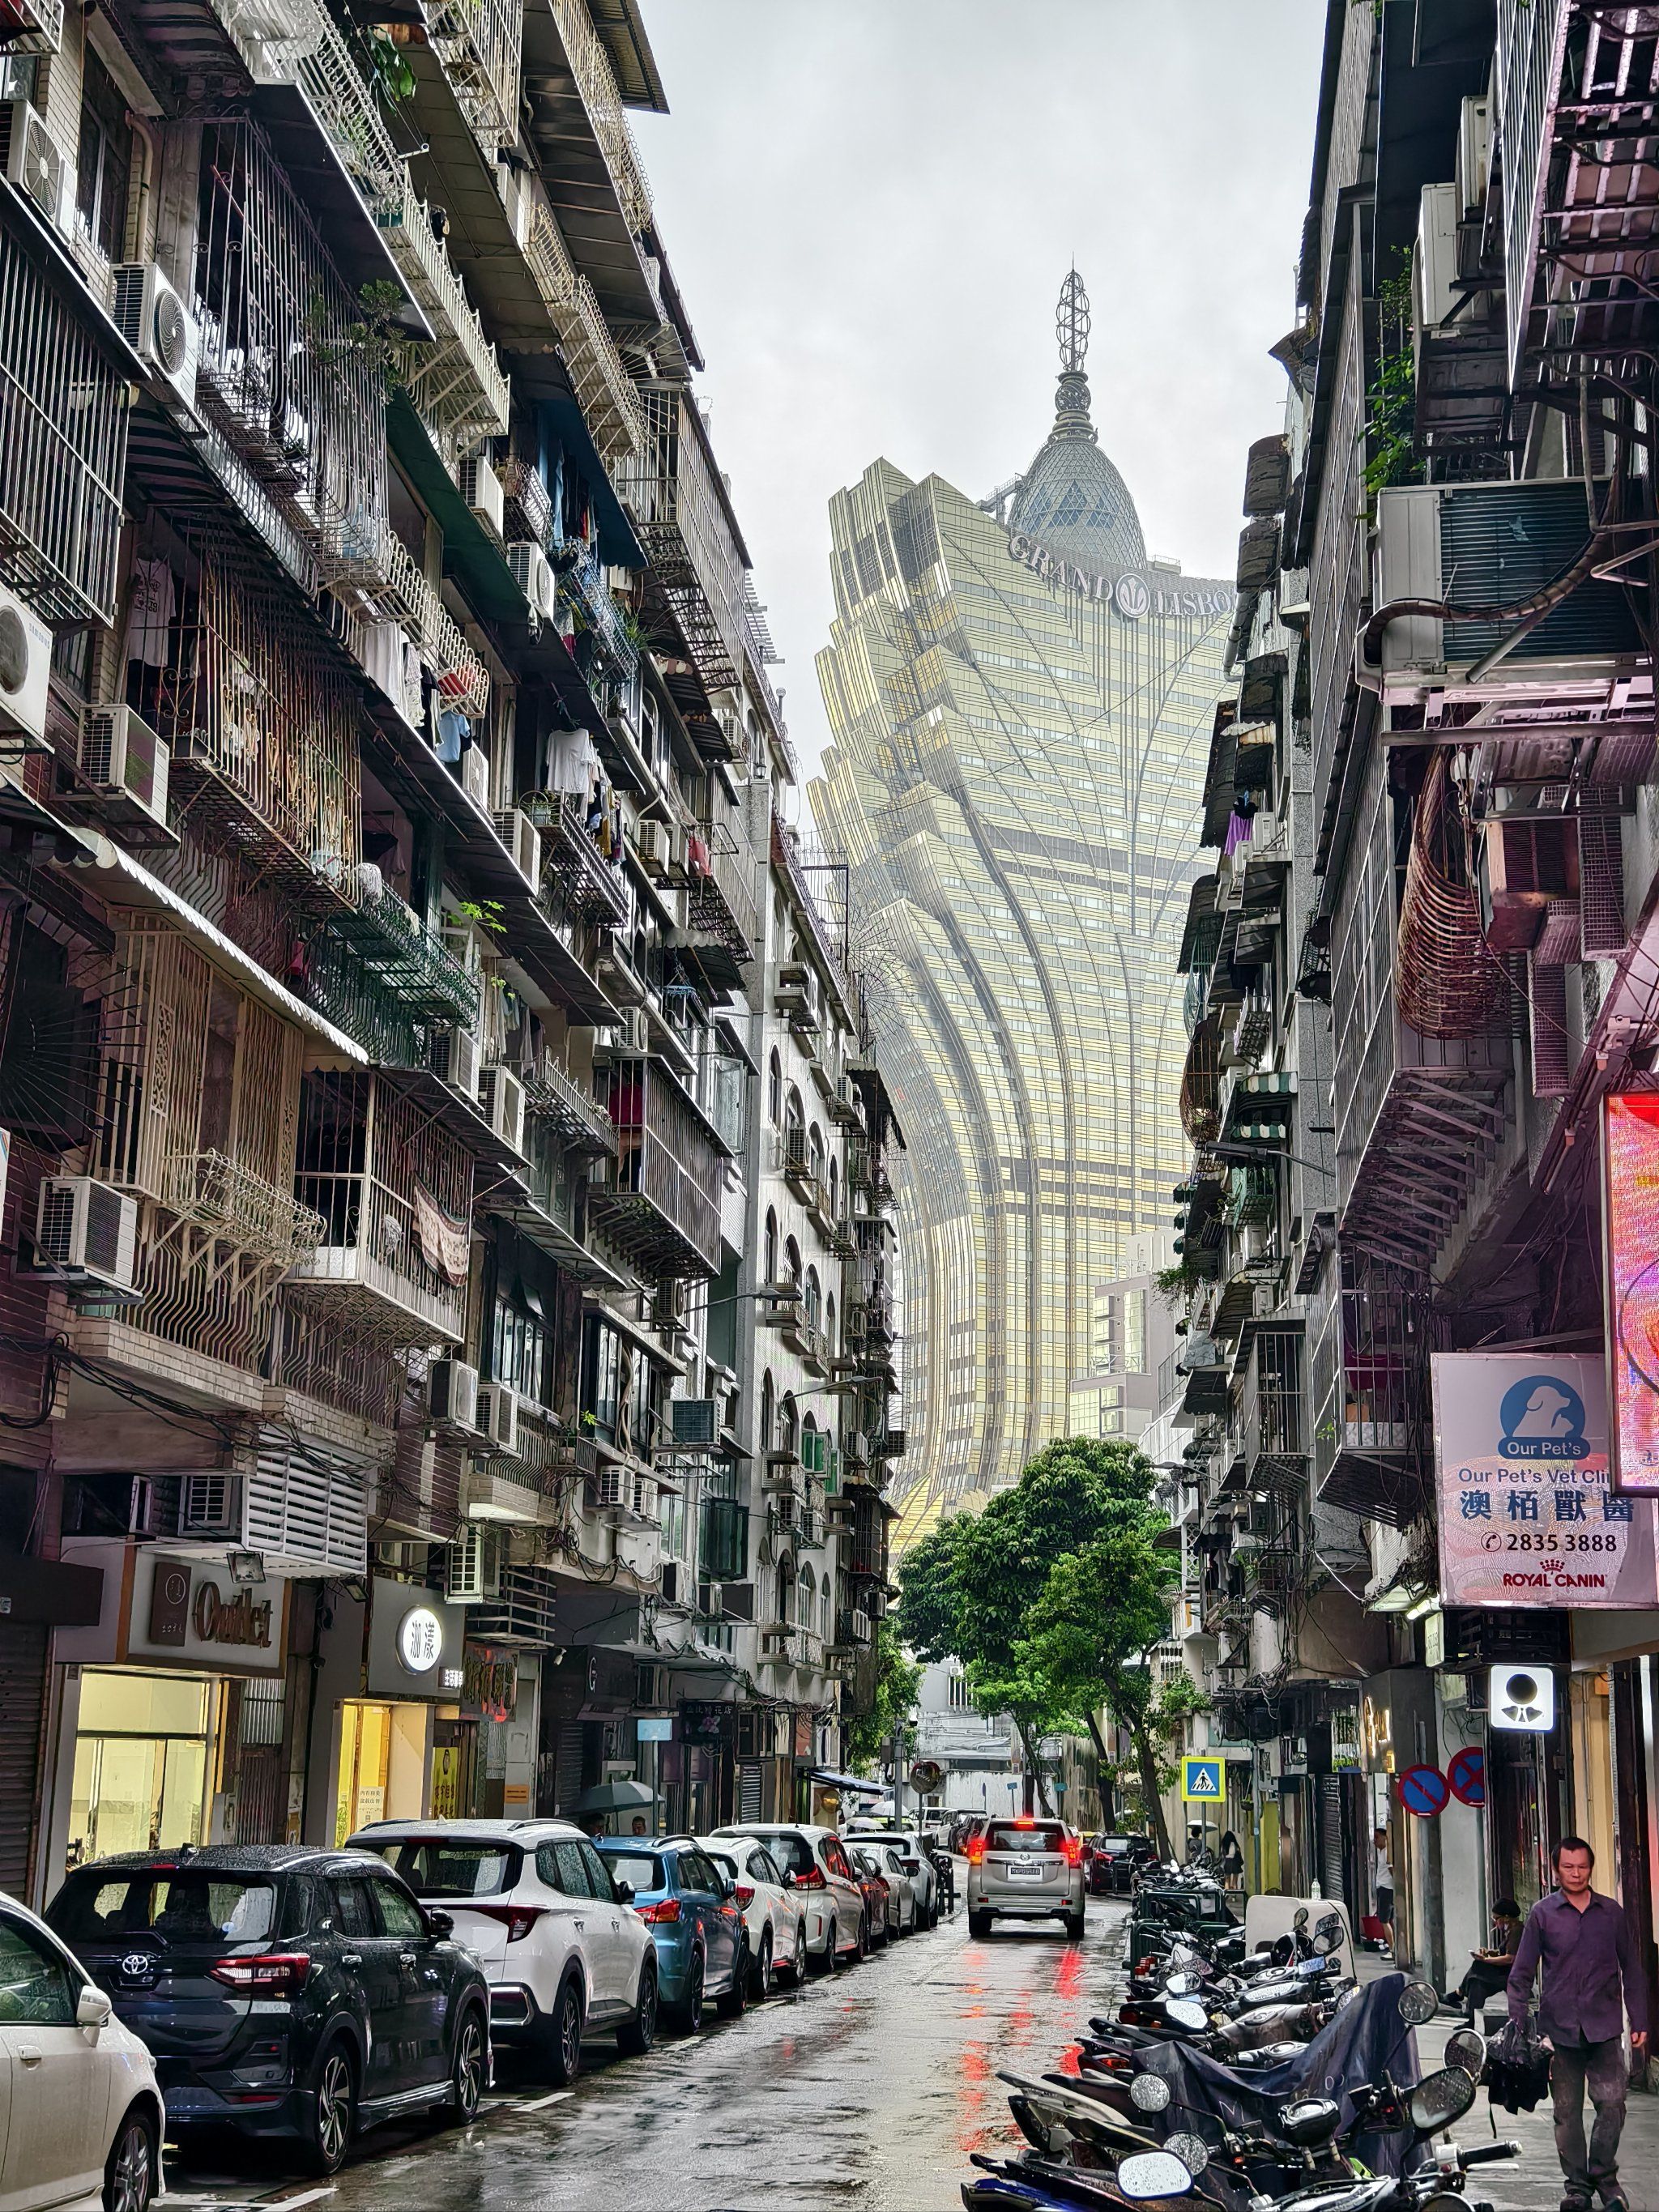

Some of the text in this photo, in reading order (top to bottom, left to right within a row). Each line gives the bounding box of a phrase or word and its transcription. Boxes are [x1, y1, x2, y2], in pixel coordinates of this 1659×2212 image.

[1009, 535, 1113, 600] GRAND
[1507, 1442, 1581, 1455] Our Pet's
[1458, 1468, 1492, 1482] Our
[1498, 1468, 1542, 1483] Pet's
[1548, 1469, 1577, 1484] Vet
[1507, 1533, 1617, 1552] 2835 3888
[1503, 1572, 1606, 1588] ROYAL CANIN
[194, 1581, 272, 1648] Outlet
